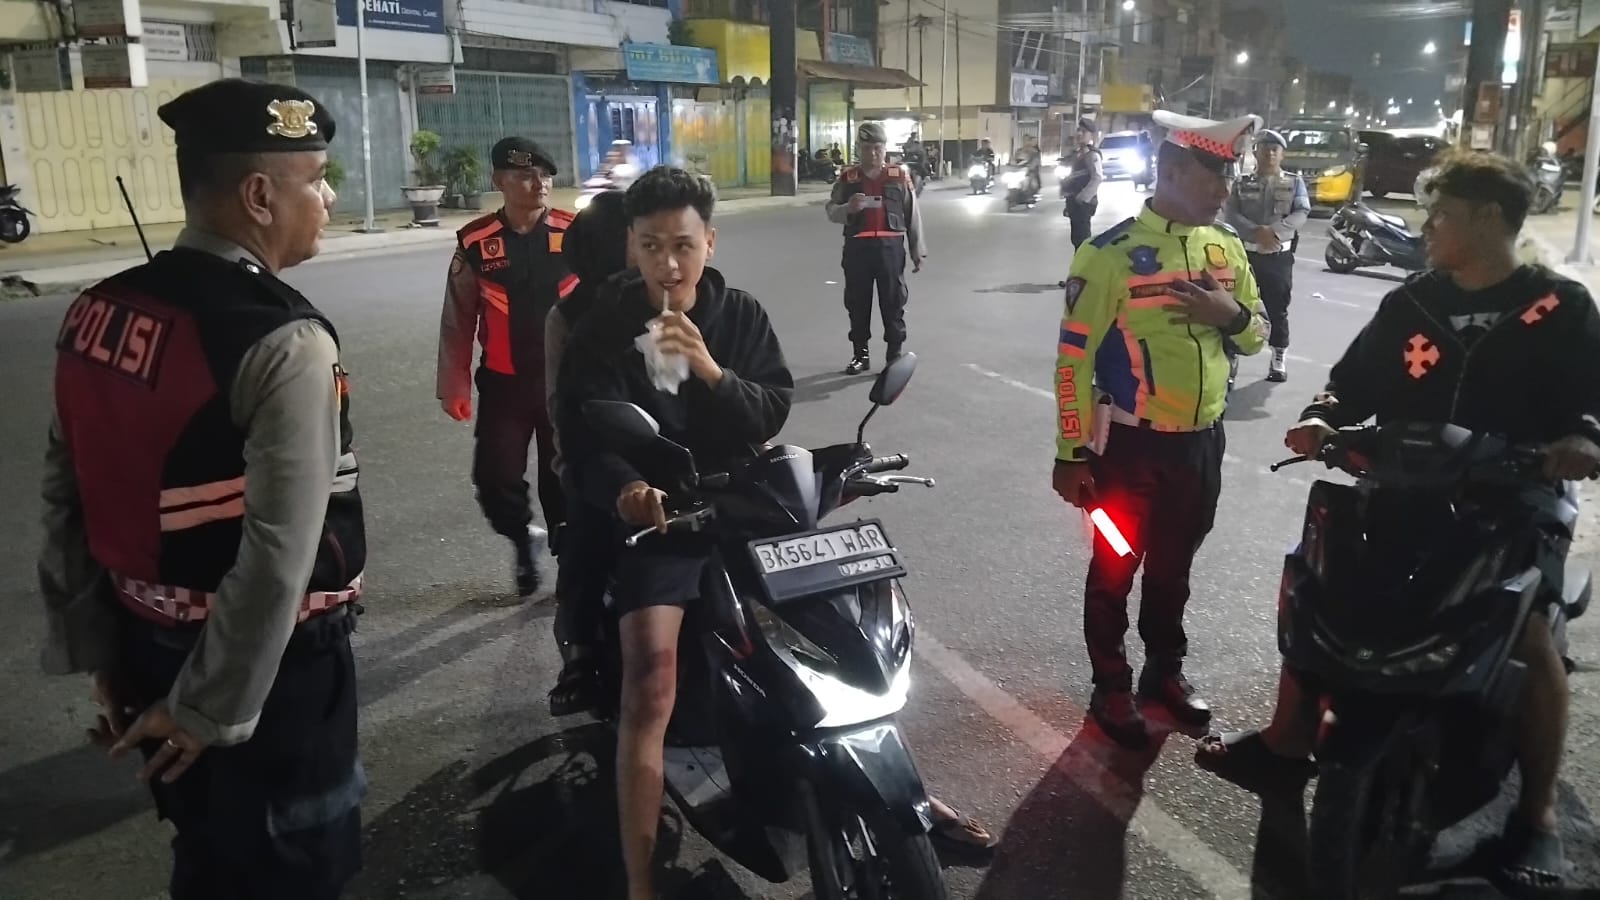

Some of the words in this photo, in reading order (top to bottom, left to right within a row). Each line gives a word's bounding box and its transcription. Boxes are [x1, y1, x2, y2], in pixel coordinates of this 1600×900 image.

[60, 295, 162, 379] POLISI
[1058, 365, 1081, 439] POLISI
[770, 453, 800, 463] HONDA
[840, 528, 883, 553] WAR
[734, 663, 767, 698] HONDA
